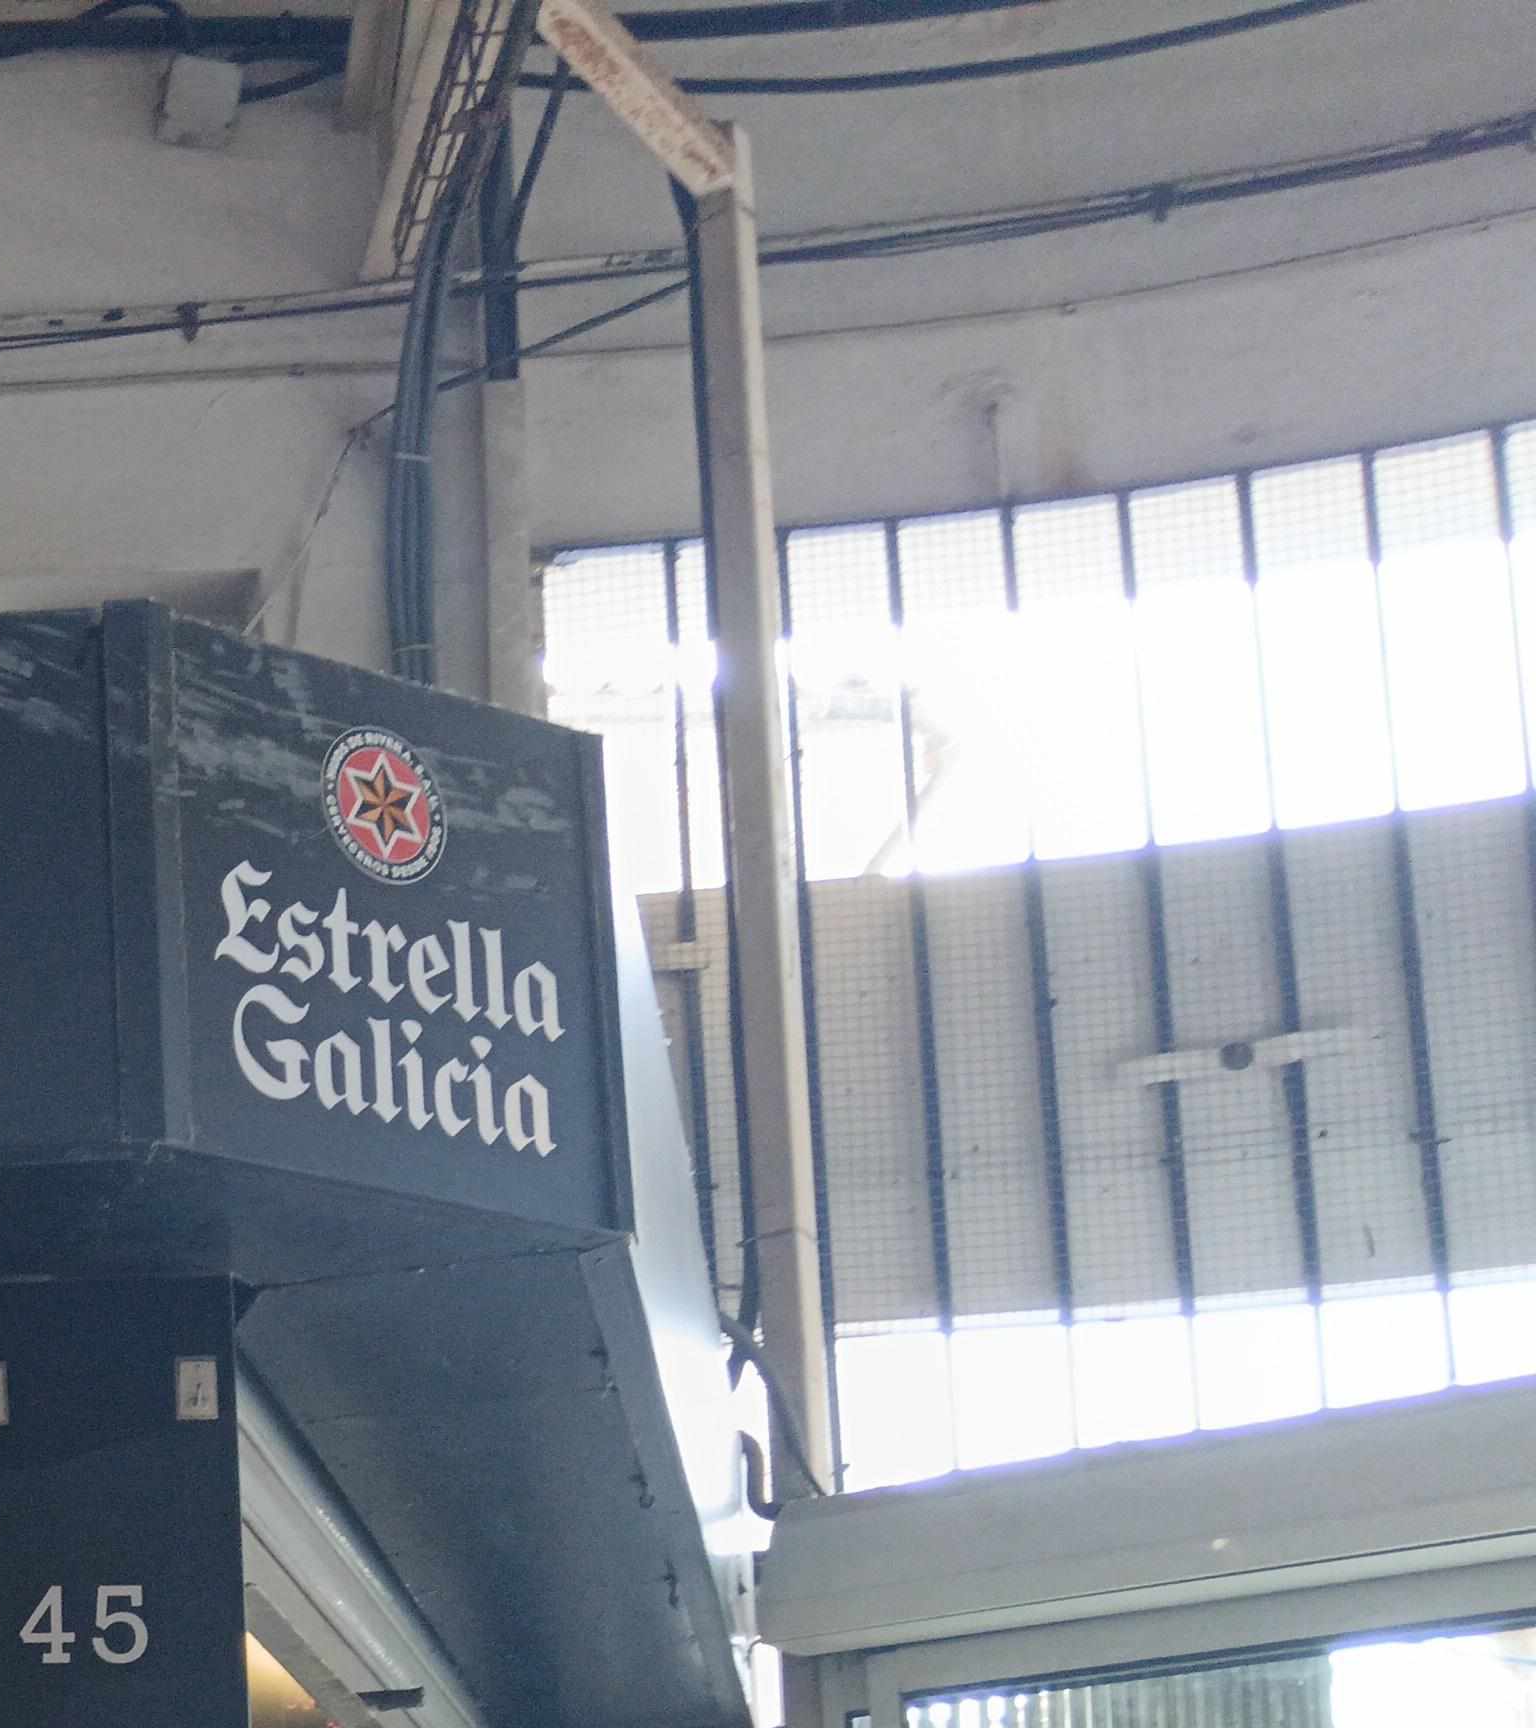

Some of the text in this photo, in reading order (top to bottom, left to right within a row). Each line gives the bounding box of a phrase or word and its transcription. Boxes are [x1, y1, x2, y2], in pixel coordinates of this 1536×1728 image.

[214, 860, 567, 1043] Estrella
[232, 984, 558, 1159] Galicia
[18, 1584, 149, 1665] 45
